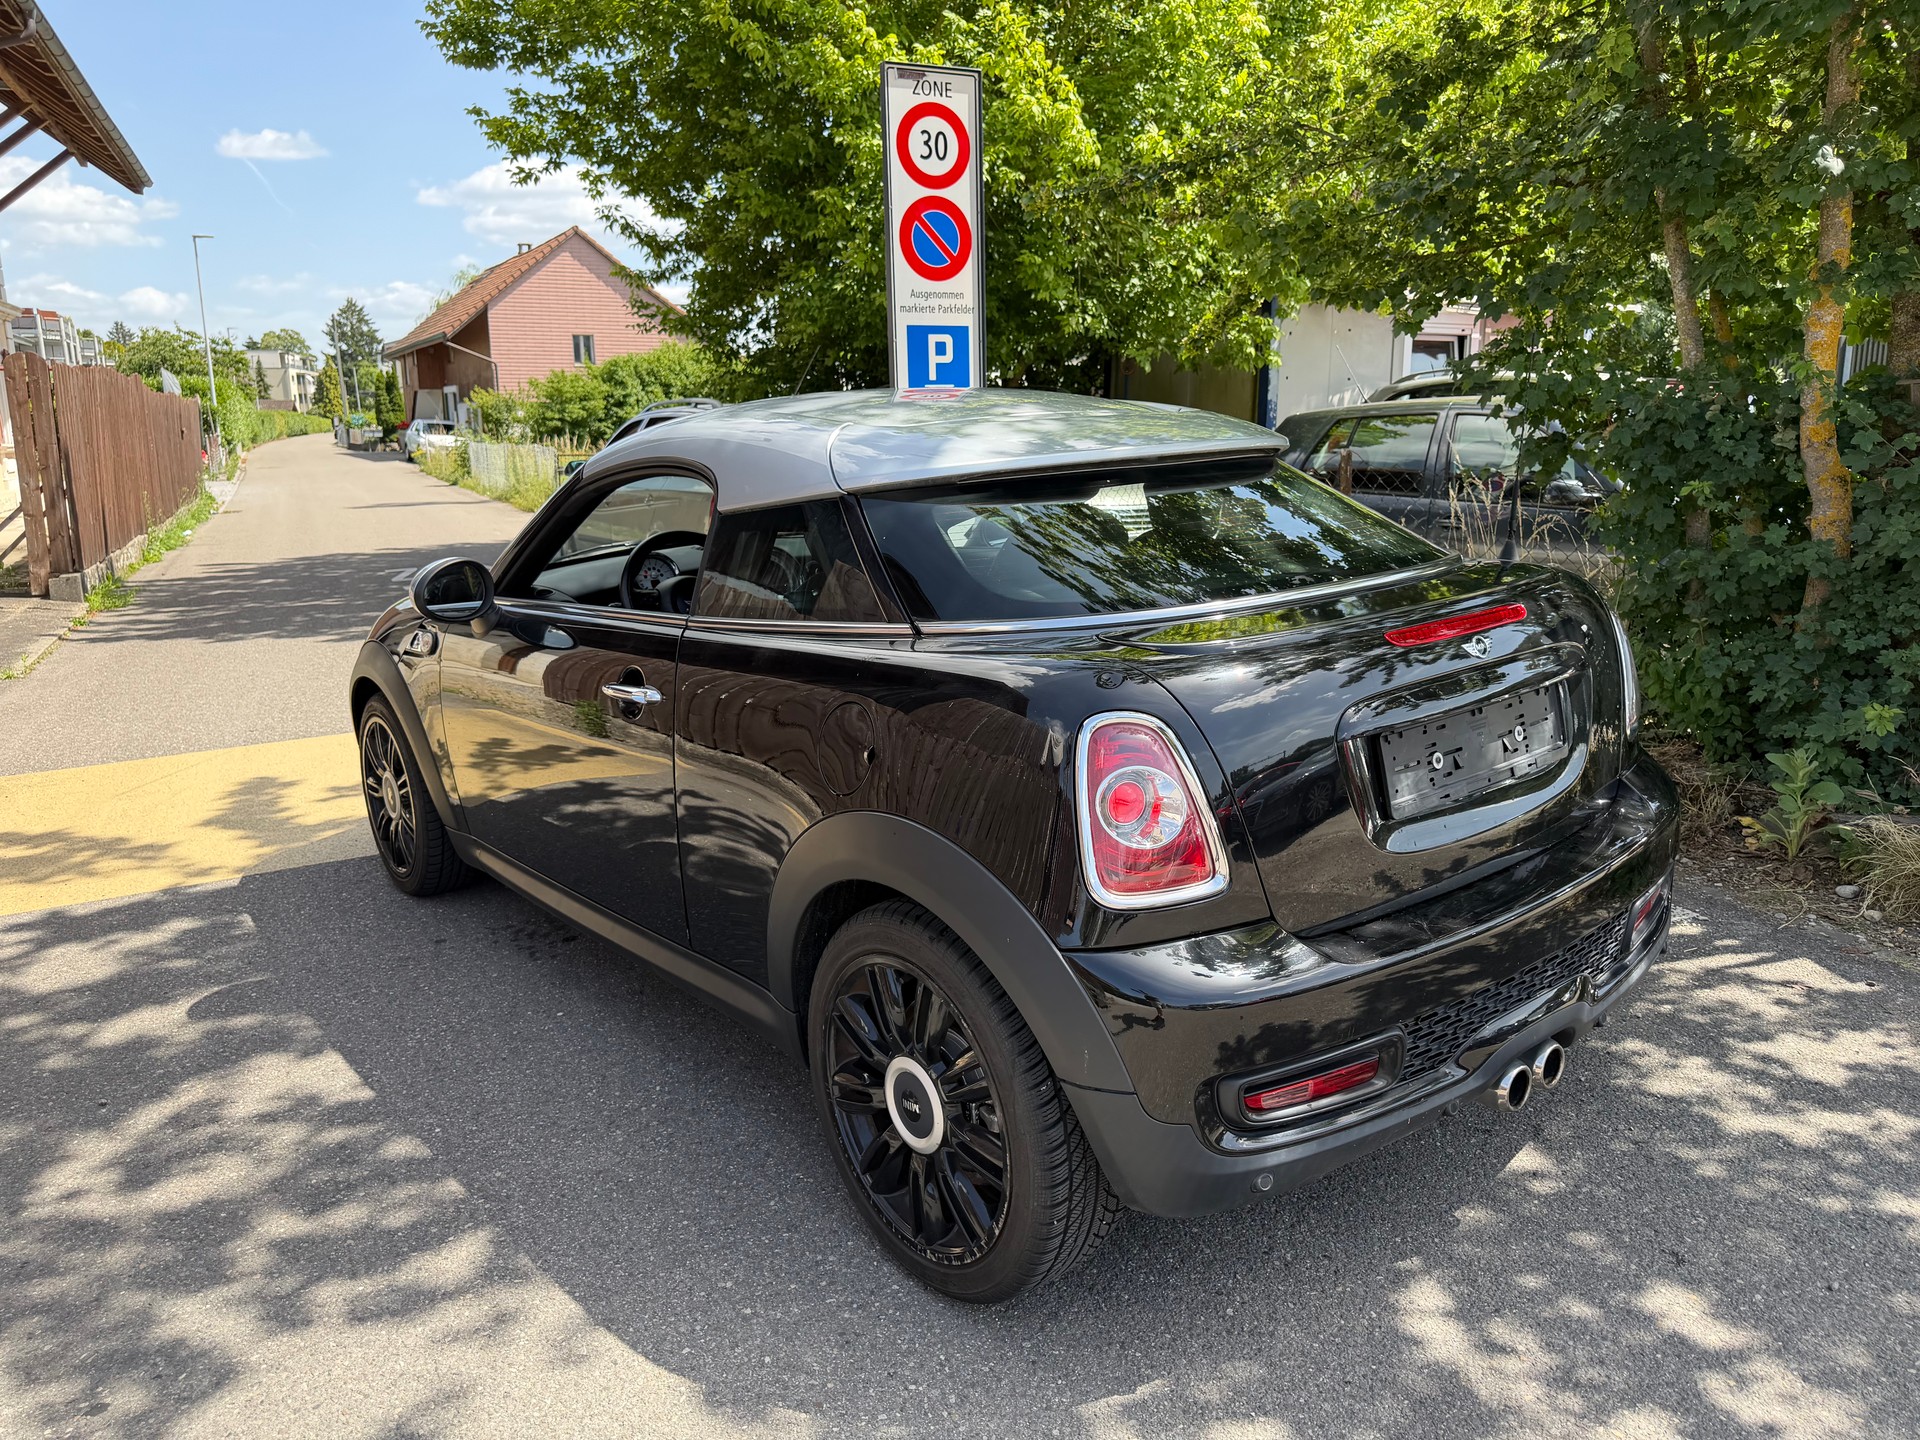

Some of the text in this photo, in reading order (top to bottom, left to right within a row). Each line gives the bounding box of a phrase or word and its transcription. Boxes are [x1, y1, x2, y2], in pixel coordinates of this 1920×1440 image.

[912, 79, 953, 98] ZONE
[919, 129, 948, 161] 30
[910, 288, 965, 301] Ausgenommen
[899, 303, 975, 314] markierte Parkfelder
[928, 334, 954, 381] P
[902, 1098, 921, 1114] MINI
